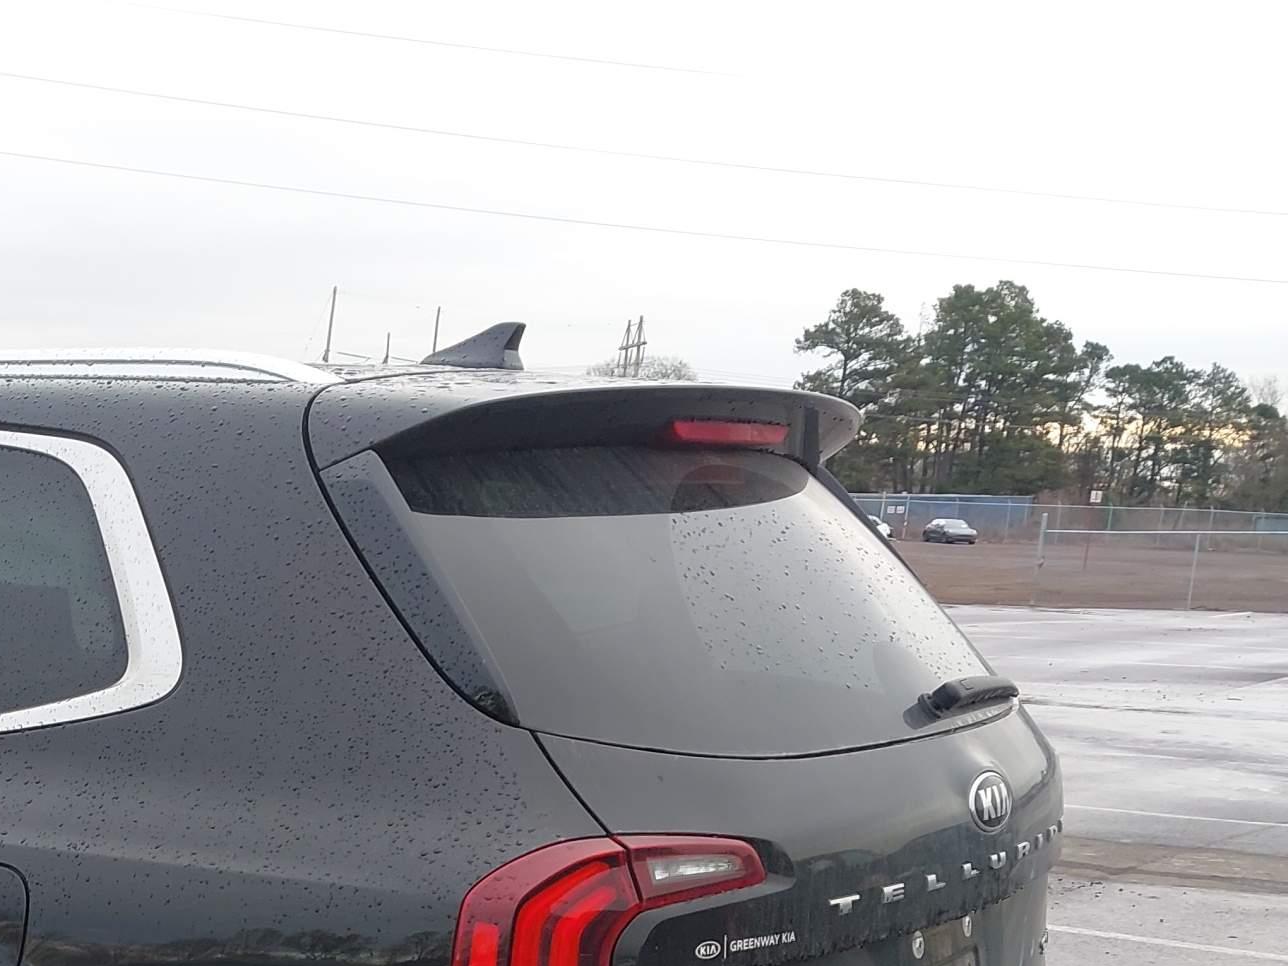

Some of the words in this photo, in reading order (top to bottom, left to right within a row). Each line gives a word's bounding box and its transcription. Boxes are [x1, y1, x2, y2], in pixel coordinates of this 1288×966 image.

[977, 782, 1010, 821] KIA
[699, 944, 718, 957] KIA
[729, 933, 781, 952] GREENWAY
[781, 930, 797, 944] KIA
